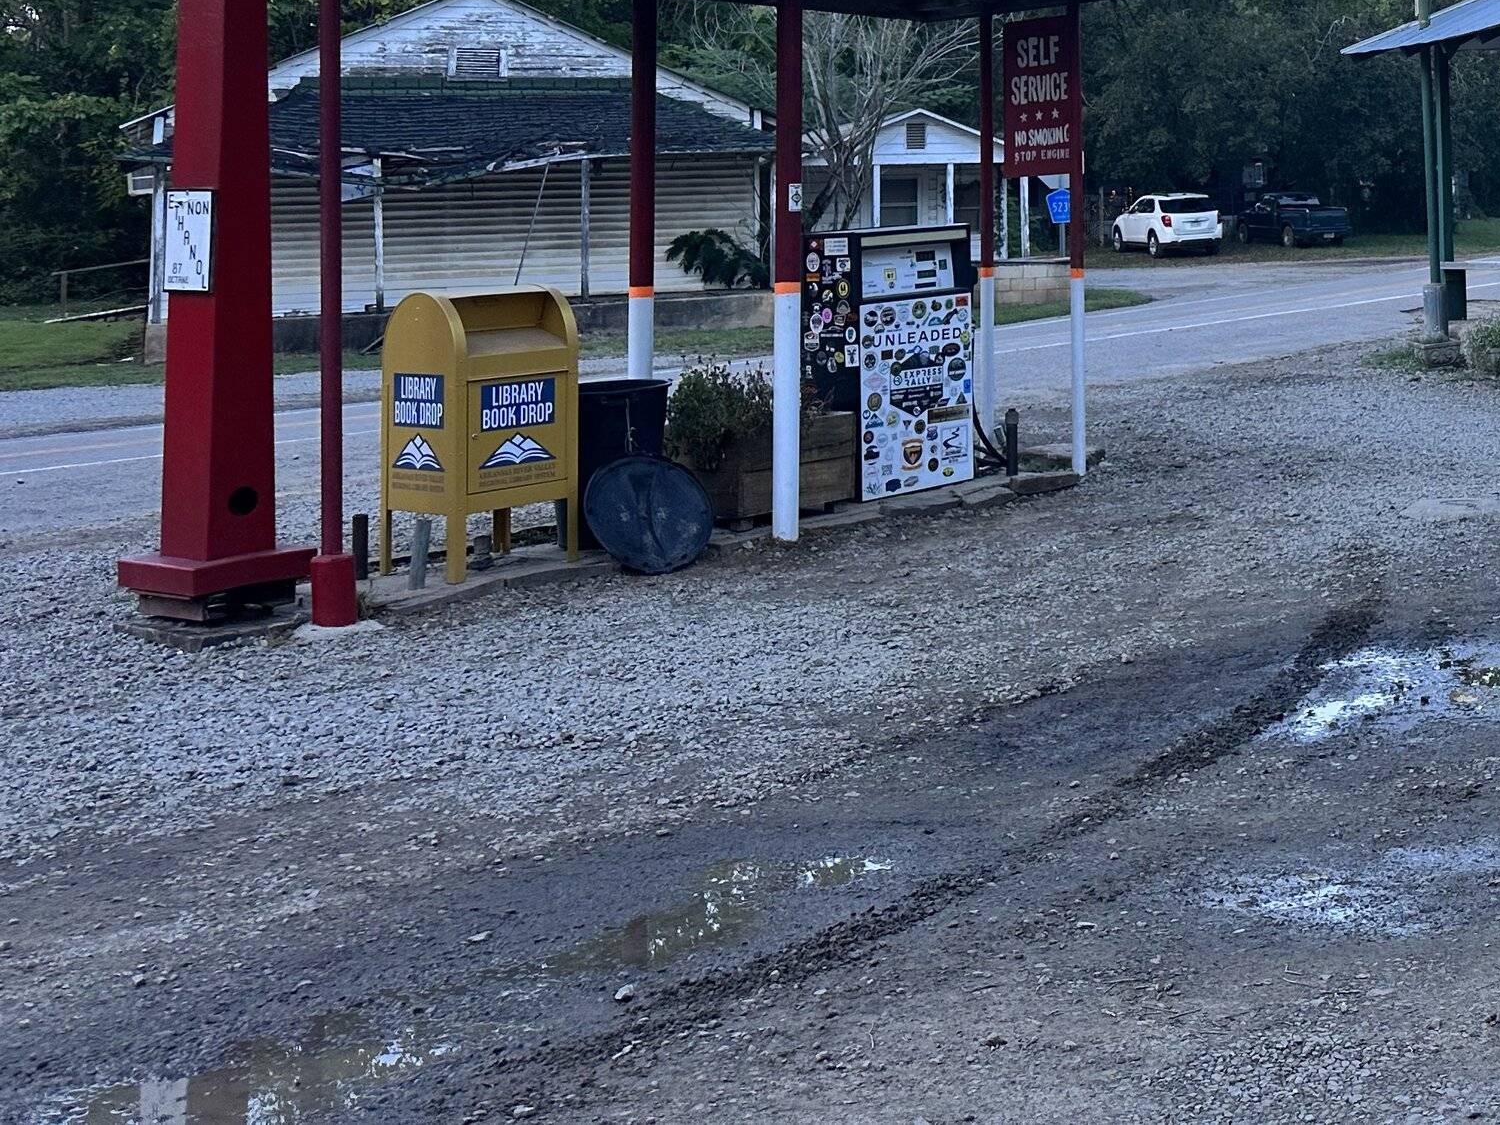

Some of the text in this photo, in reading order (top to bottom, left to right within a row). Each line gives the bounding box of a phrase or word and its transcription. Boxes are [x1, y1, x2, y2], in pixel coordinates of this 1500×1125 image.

[1017, 35, 1060, 68] SELF
[1011, 72, 1069, 106] SERVICE
[1014, 130, 1027, 148] NO
[1014, 148, 1070, 166] STOP ENGINE
[187, 201, 210, 216] NON
[1052, 201, 1068, 213] 523
[172, 262, 183, 275] 87
[872, 327, 961, 348] UNLEADED
[904, 367, 942, 379] EXPRESS
[400, 376, 437, 400] LIBRARY
[492, 381, 544, 406] LIBRARY
[394, 401, 443, 426] BOOK DROP
[482, 402, 553, 430] BOOK DROP
